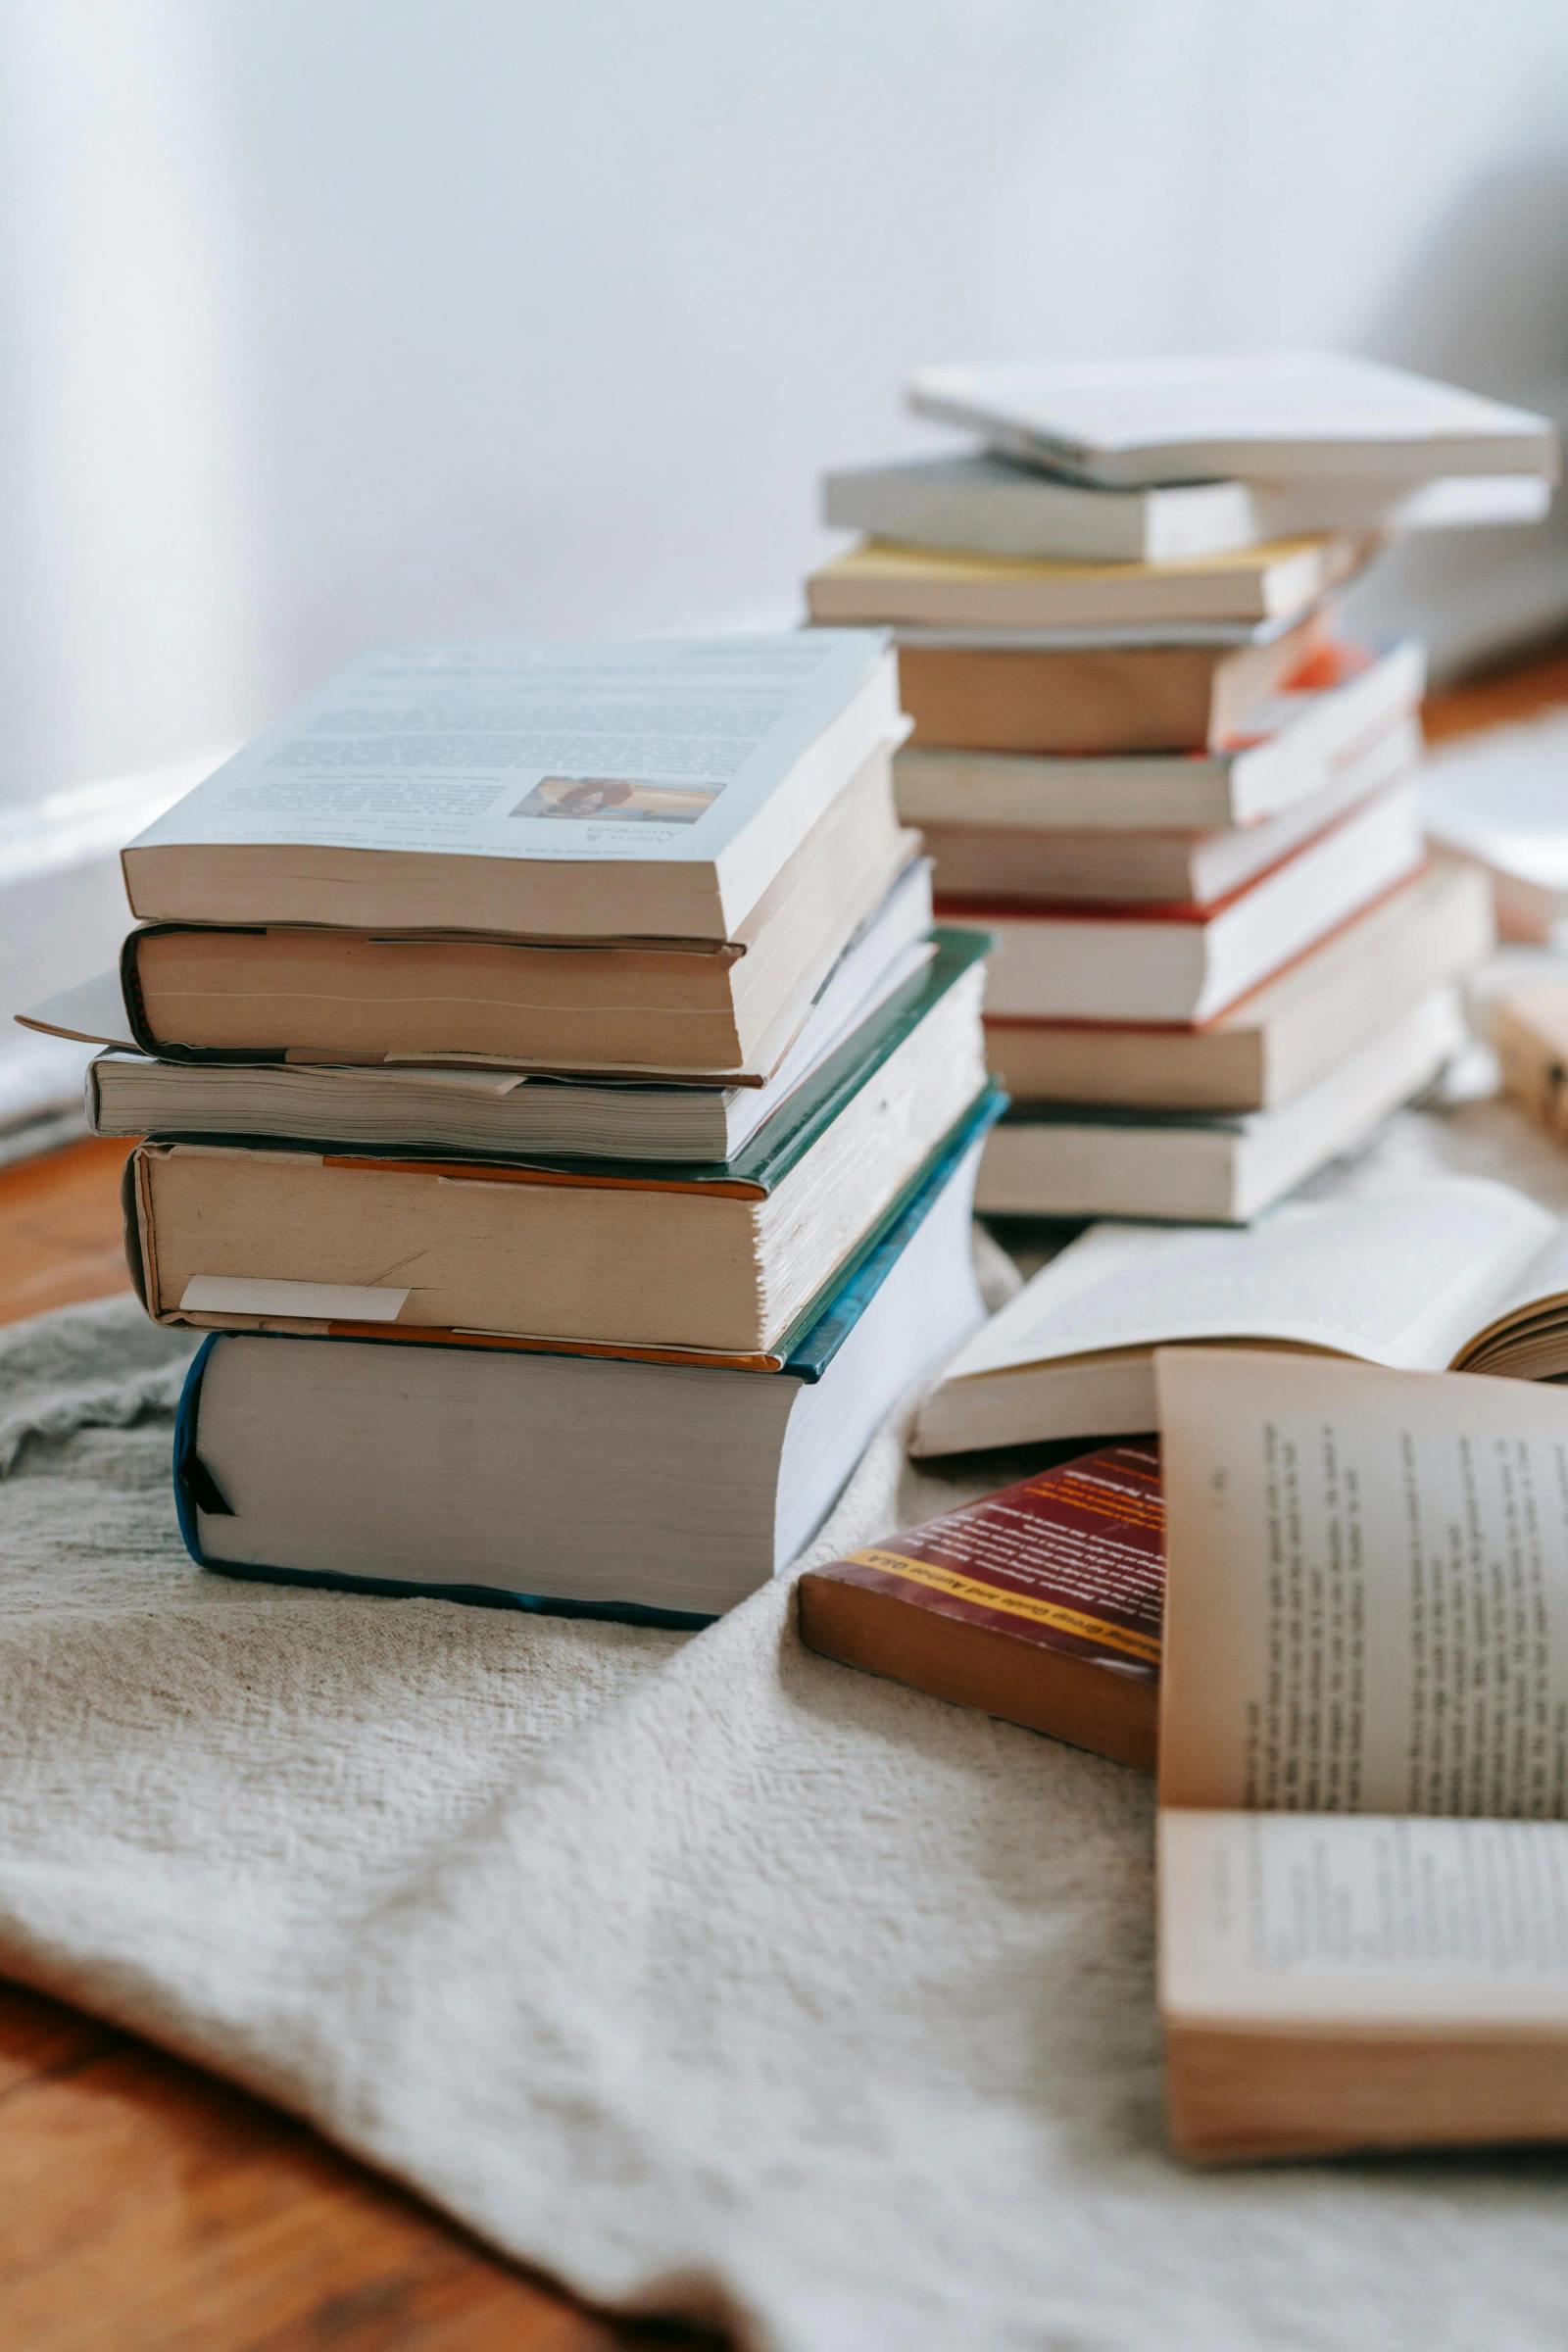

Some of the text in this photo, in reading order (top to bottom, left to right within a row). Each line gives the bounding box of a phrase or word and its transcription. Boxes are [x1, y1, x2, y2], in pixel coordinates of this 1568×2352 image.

[863, 1552, 910, 1572] Q&A
[905, 1565, 969, 1592] Author
[963, 1584, 1002, 1602] and
[999, 1594, 1051, 1619] Guide
[1049, 1609, 1103, 1637] Group
